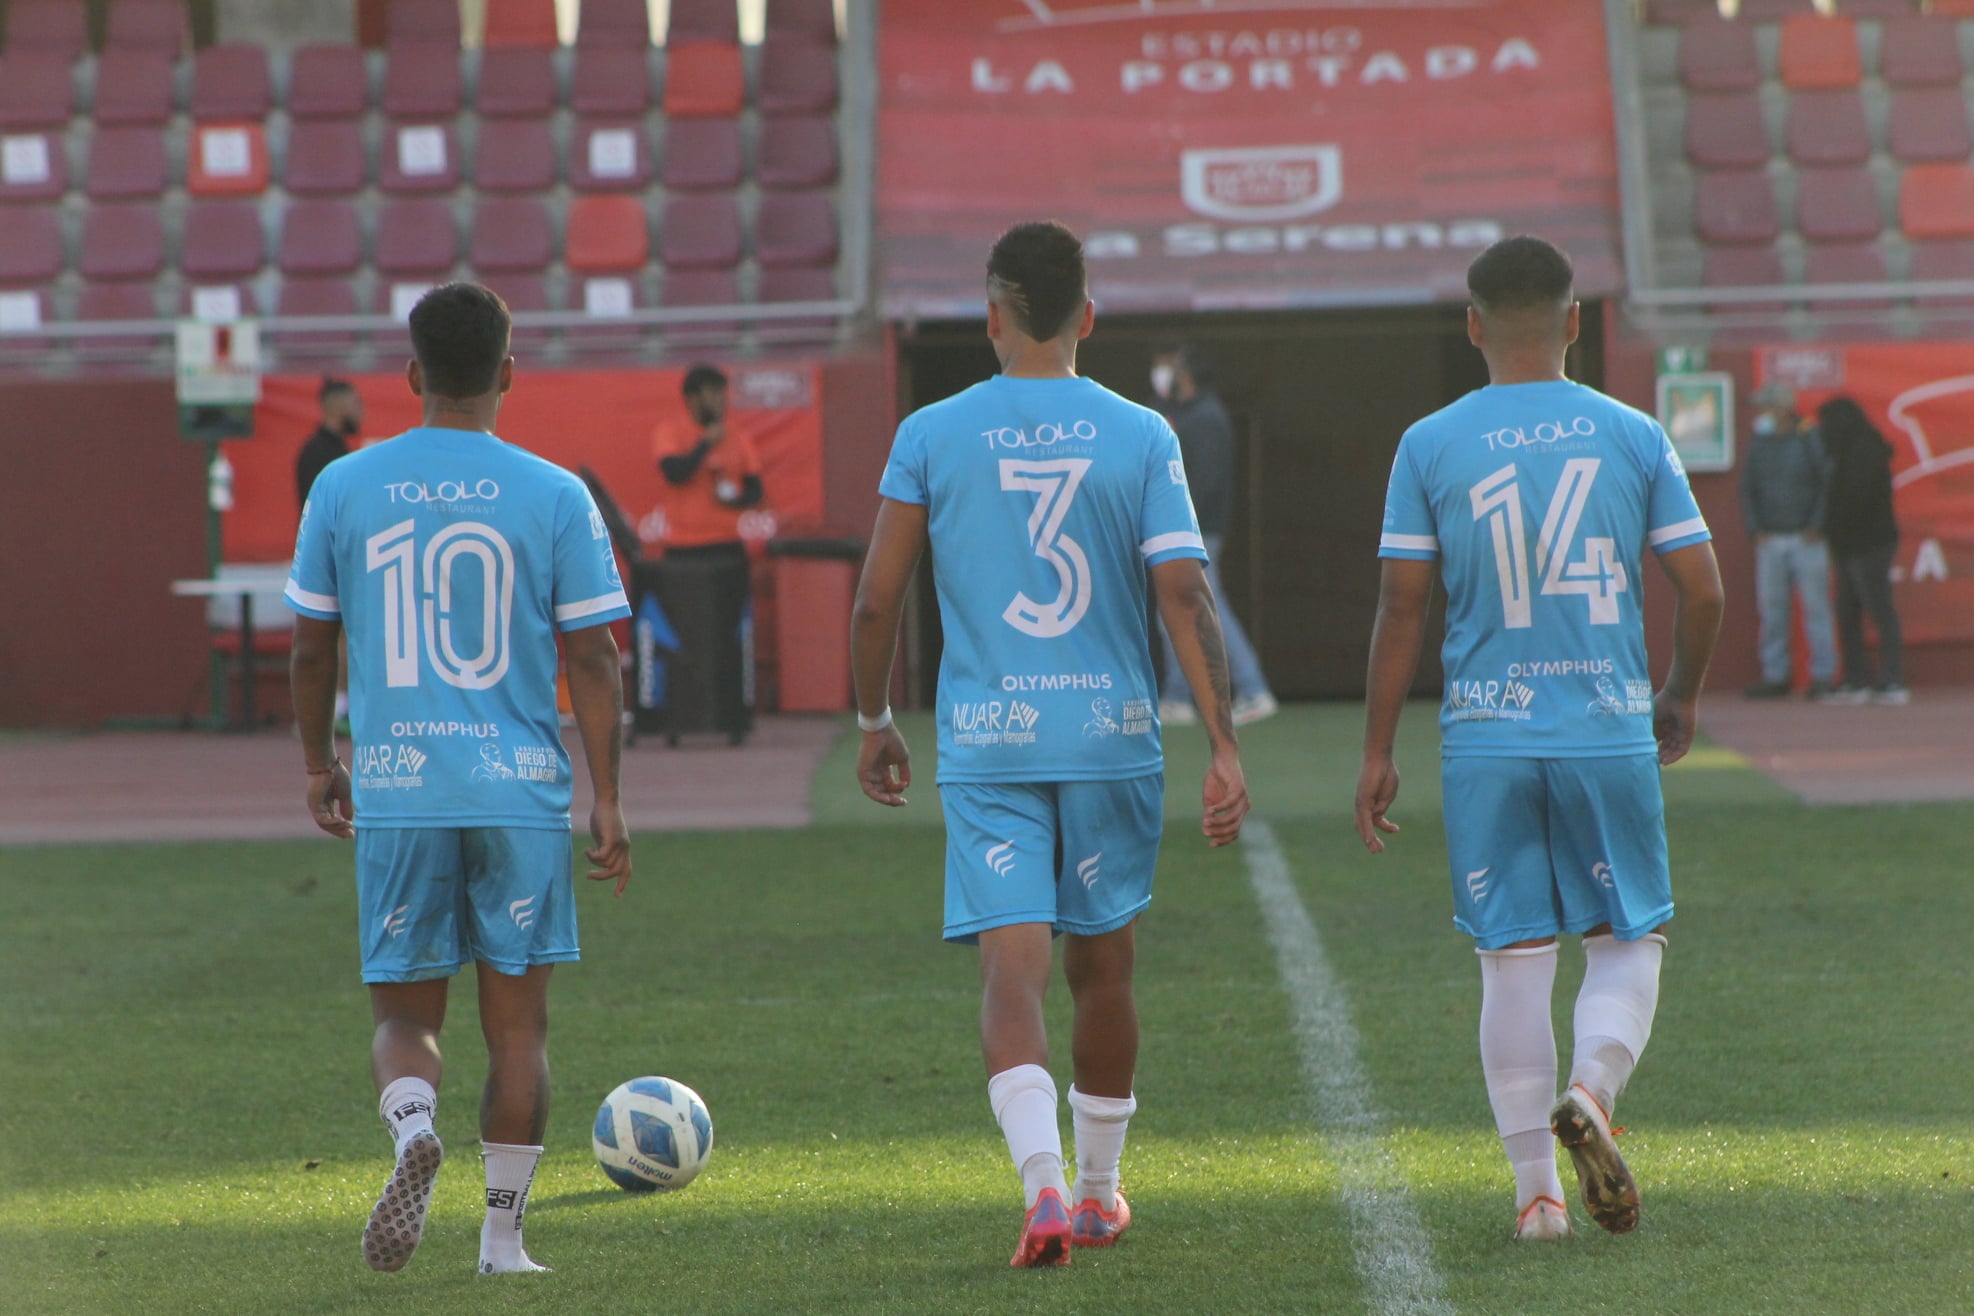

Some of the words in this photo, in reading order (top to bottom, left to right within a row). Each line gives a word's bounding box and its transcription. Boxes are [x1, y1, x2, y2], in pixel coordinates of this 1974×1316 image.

[1142, 27, 1362, 57] ESTADIO
[971, 56, 1074, 94] LA
[1121, 36, 1541, 94] PORTADA
[1084, 231, 1140, 258] a
[1163, 219, 1503, 258] Serena
[981, 420, 1097, 450] TOLOLO
[1481, 416, 1596, 451] TOLOLO
[384, 478, 500, 504] TOLOLO
[998, 458, 1094, 638] 3
[1469, 458, 1628, 629] 14
[366, 517, 515, 690] 10
[1002, 673, 1113, 691] OLYMPHUS
[1508, 658, 1614, 678] OLYMPHUS
[391, 721, 500, 739] OLYMPHUS
[515, 751, 546, 767] DIEGO
[517, 765, 557, 784] ALMAGRO
[628, 1156, 673, 1180] molten
[487, 1189, 514, 1209] FS
